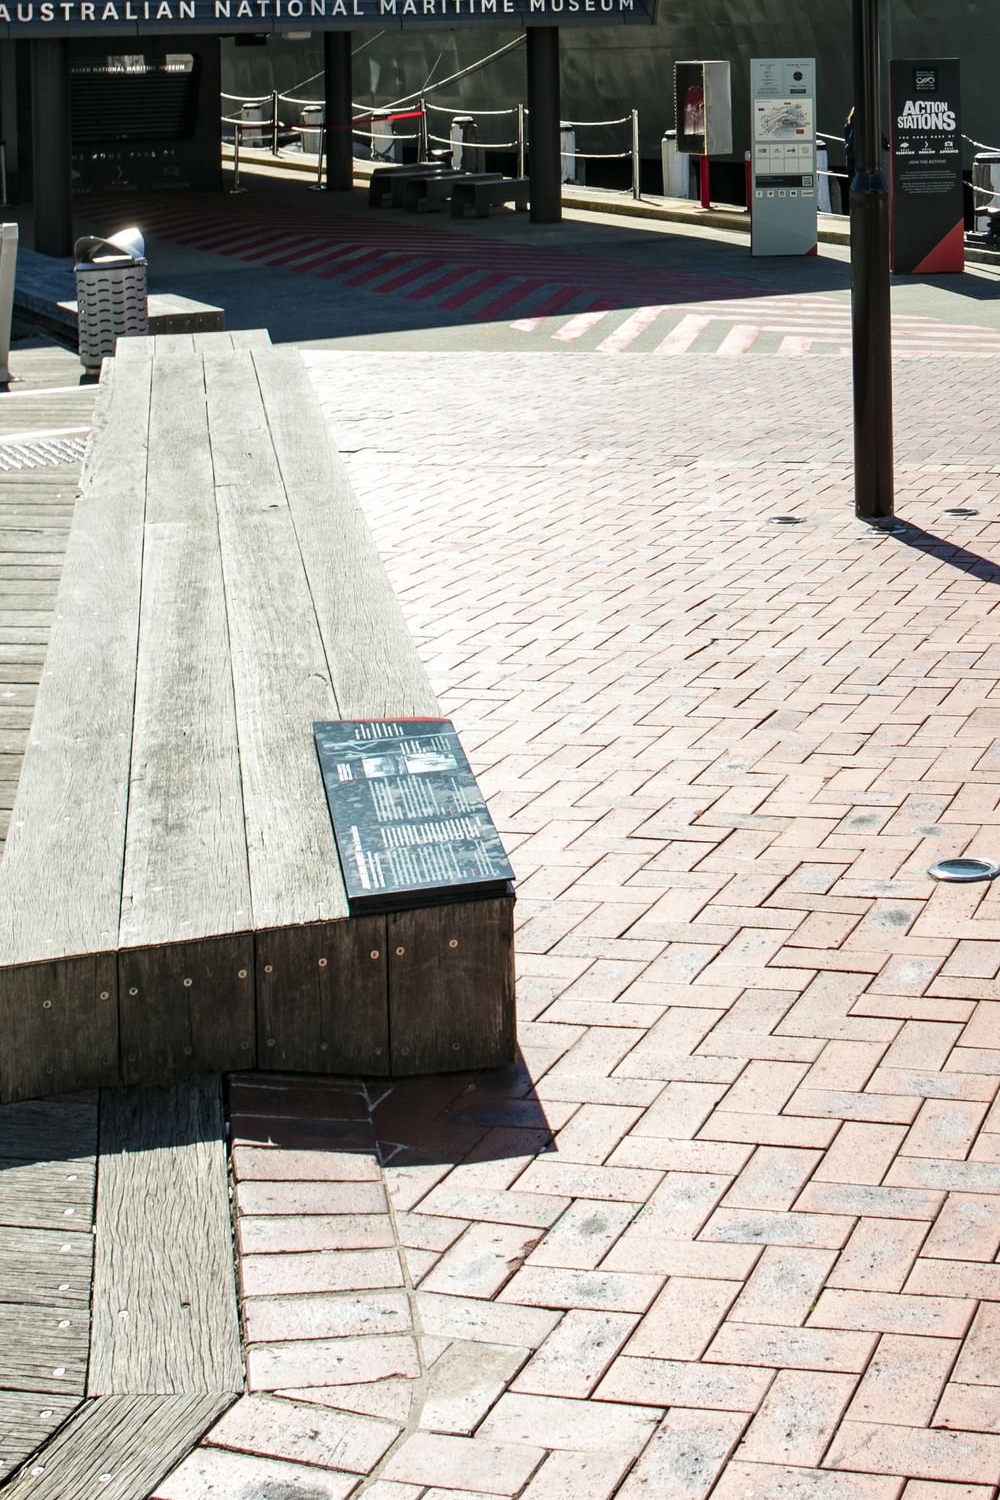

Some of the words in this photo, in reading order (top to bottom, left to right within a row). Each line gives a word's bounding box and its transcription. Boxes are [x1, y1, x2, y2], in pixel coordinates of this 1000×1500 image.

[0, 0, 196, 22] AUSTRALIAN
[902, 100, 948, 116] ACTION
[897, 111, 956, 131] STATIONS
